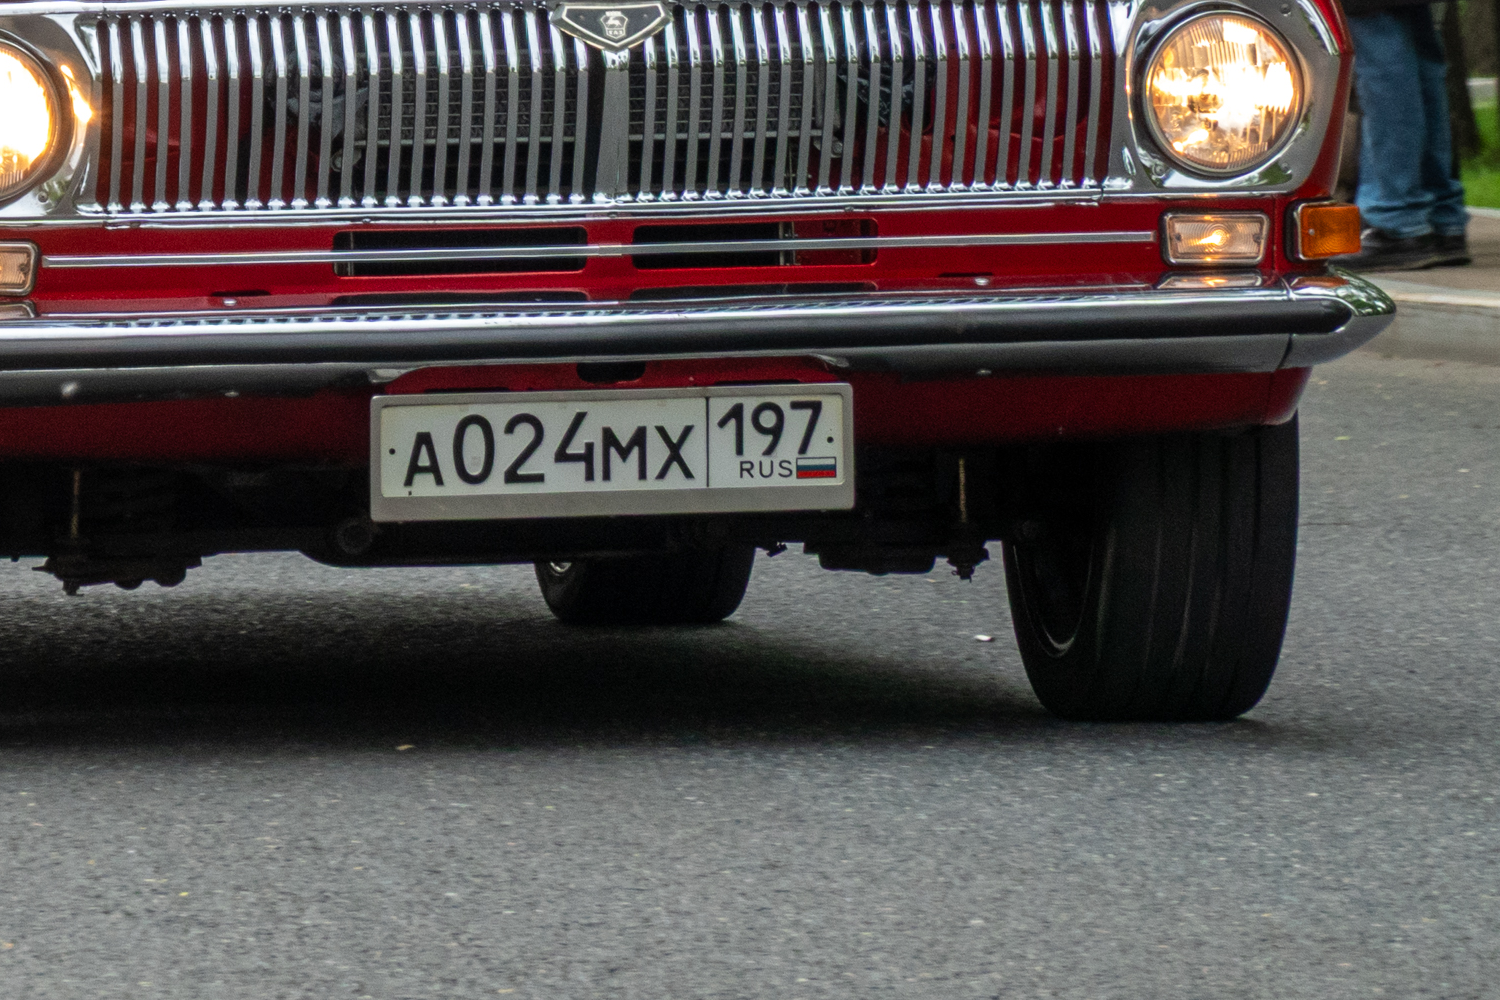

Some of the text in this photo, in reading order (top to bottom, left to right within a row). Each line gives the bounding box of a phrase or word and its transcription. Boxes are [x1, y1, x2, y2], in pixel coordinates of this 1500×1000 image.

[403, 401, 823, 487] А024МХ 197
[739, 460, 794, 479] RUS
